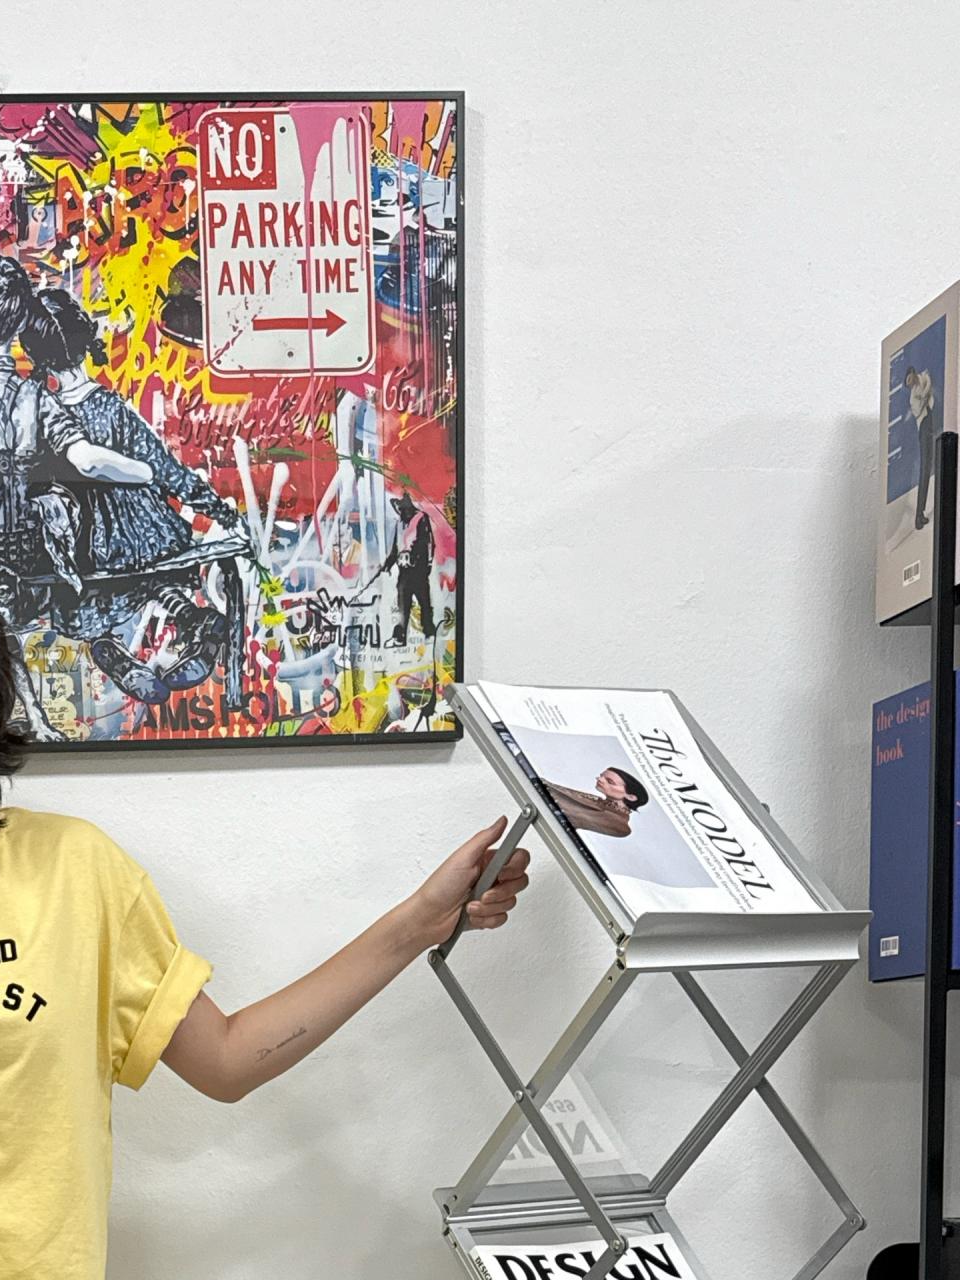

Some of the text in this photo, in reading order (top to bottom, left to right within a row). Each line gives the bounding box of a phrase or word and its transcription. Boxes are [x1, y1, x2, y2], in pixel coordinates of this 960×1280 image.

[206, 121, 264, 179] NO
[208, 199, 362, 249] PARKING
[218, 257, 360, 295] ANY TIME
[876, 738, 904, 767] book
